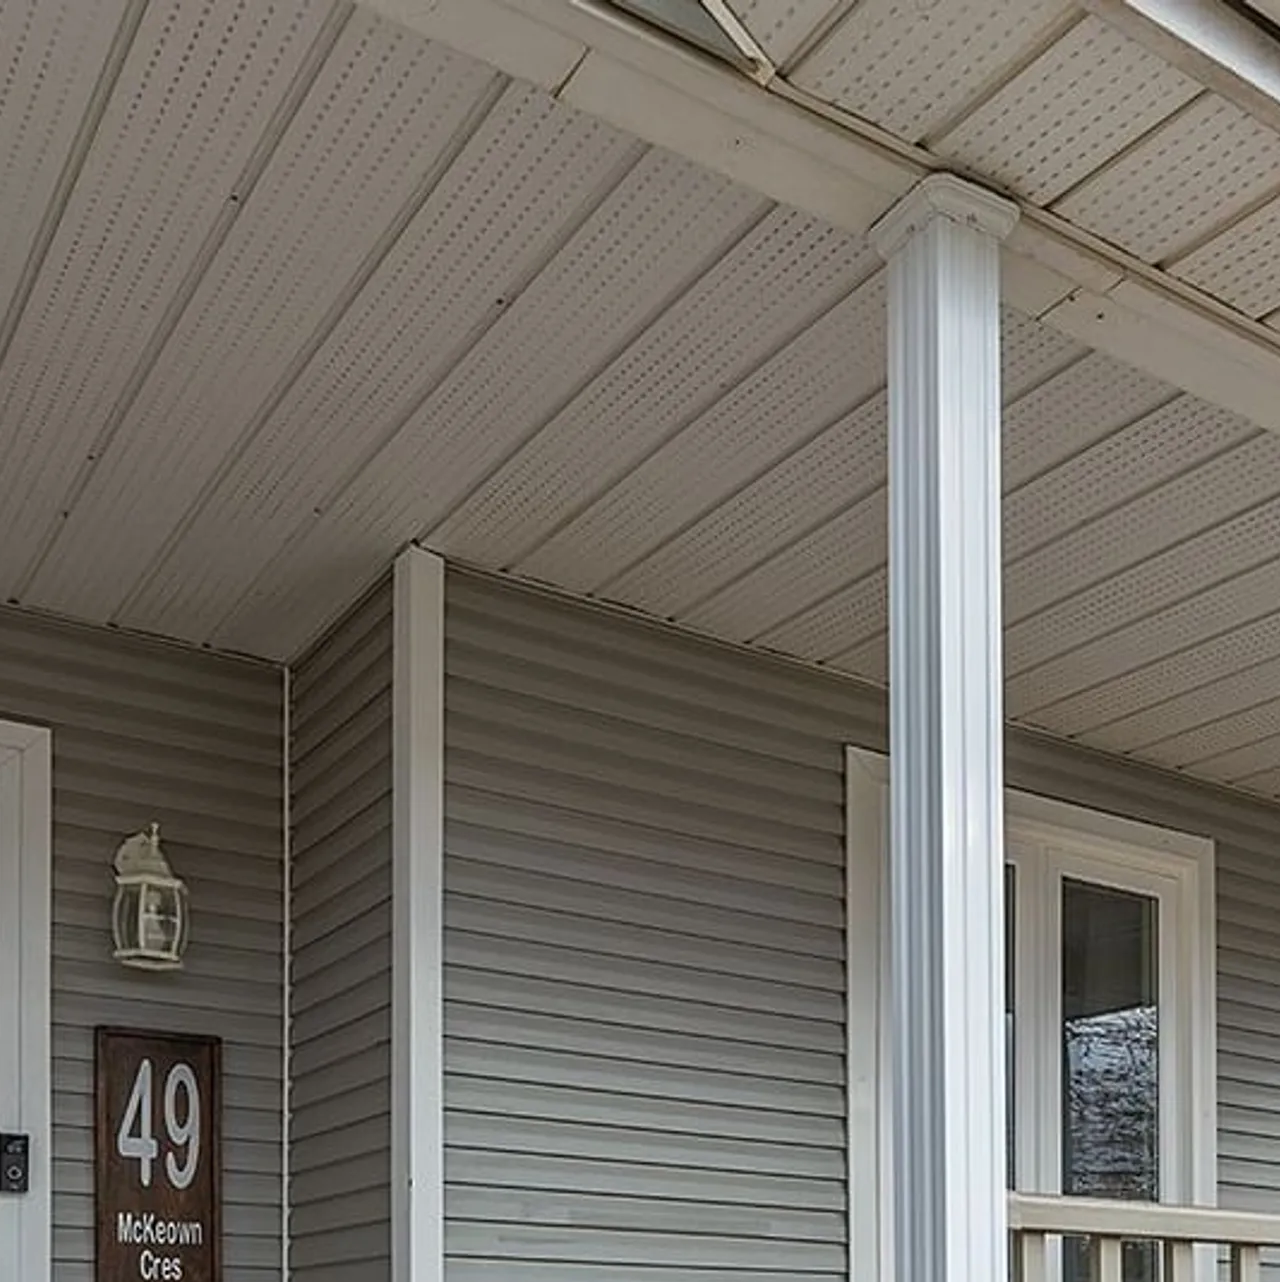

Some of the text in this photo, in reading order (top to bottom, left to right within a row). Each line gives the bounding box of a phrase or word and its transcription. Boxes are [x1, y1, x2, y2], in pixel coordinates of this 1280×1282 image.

[117, 1058, 201, 1189] 49
[117, 1212, 203, 1246] McKeown
[140, 1252, 182, 1281] Cres
